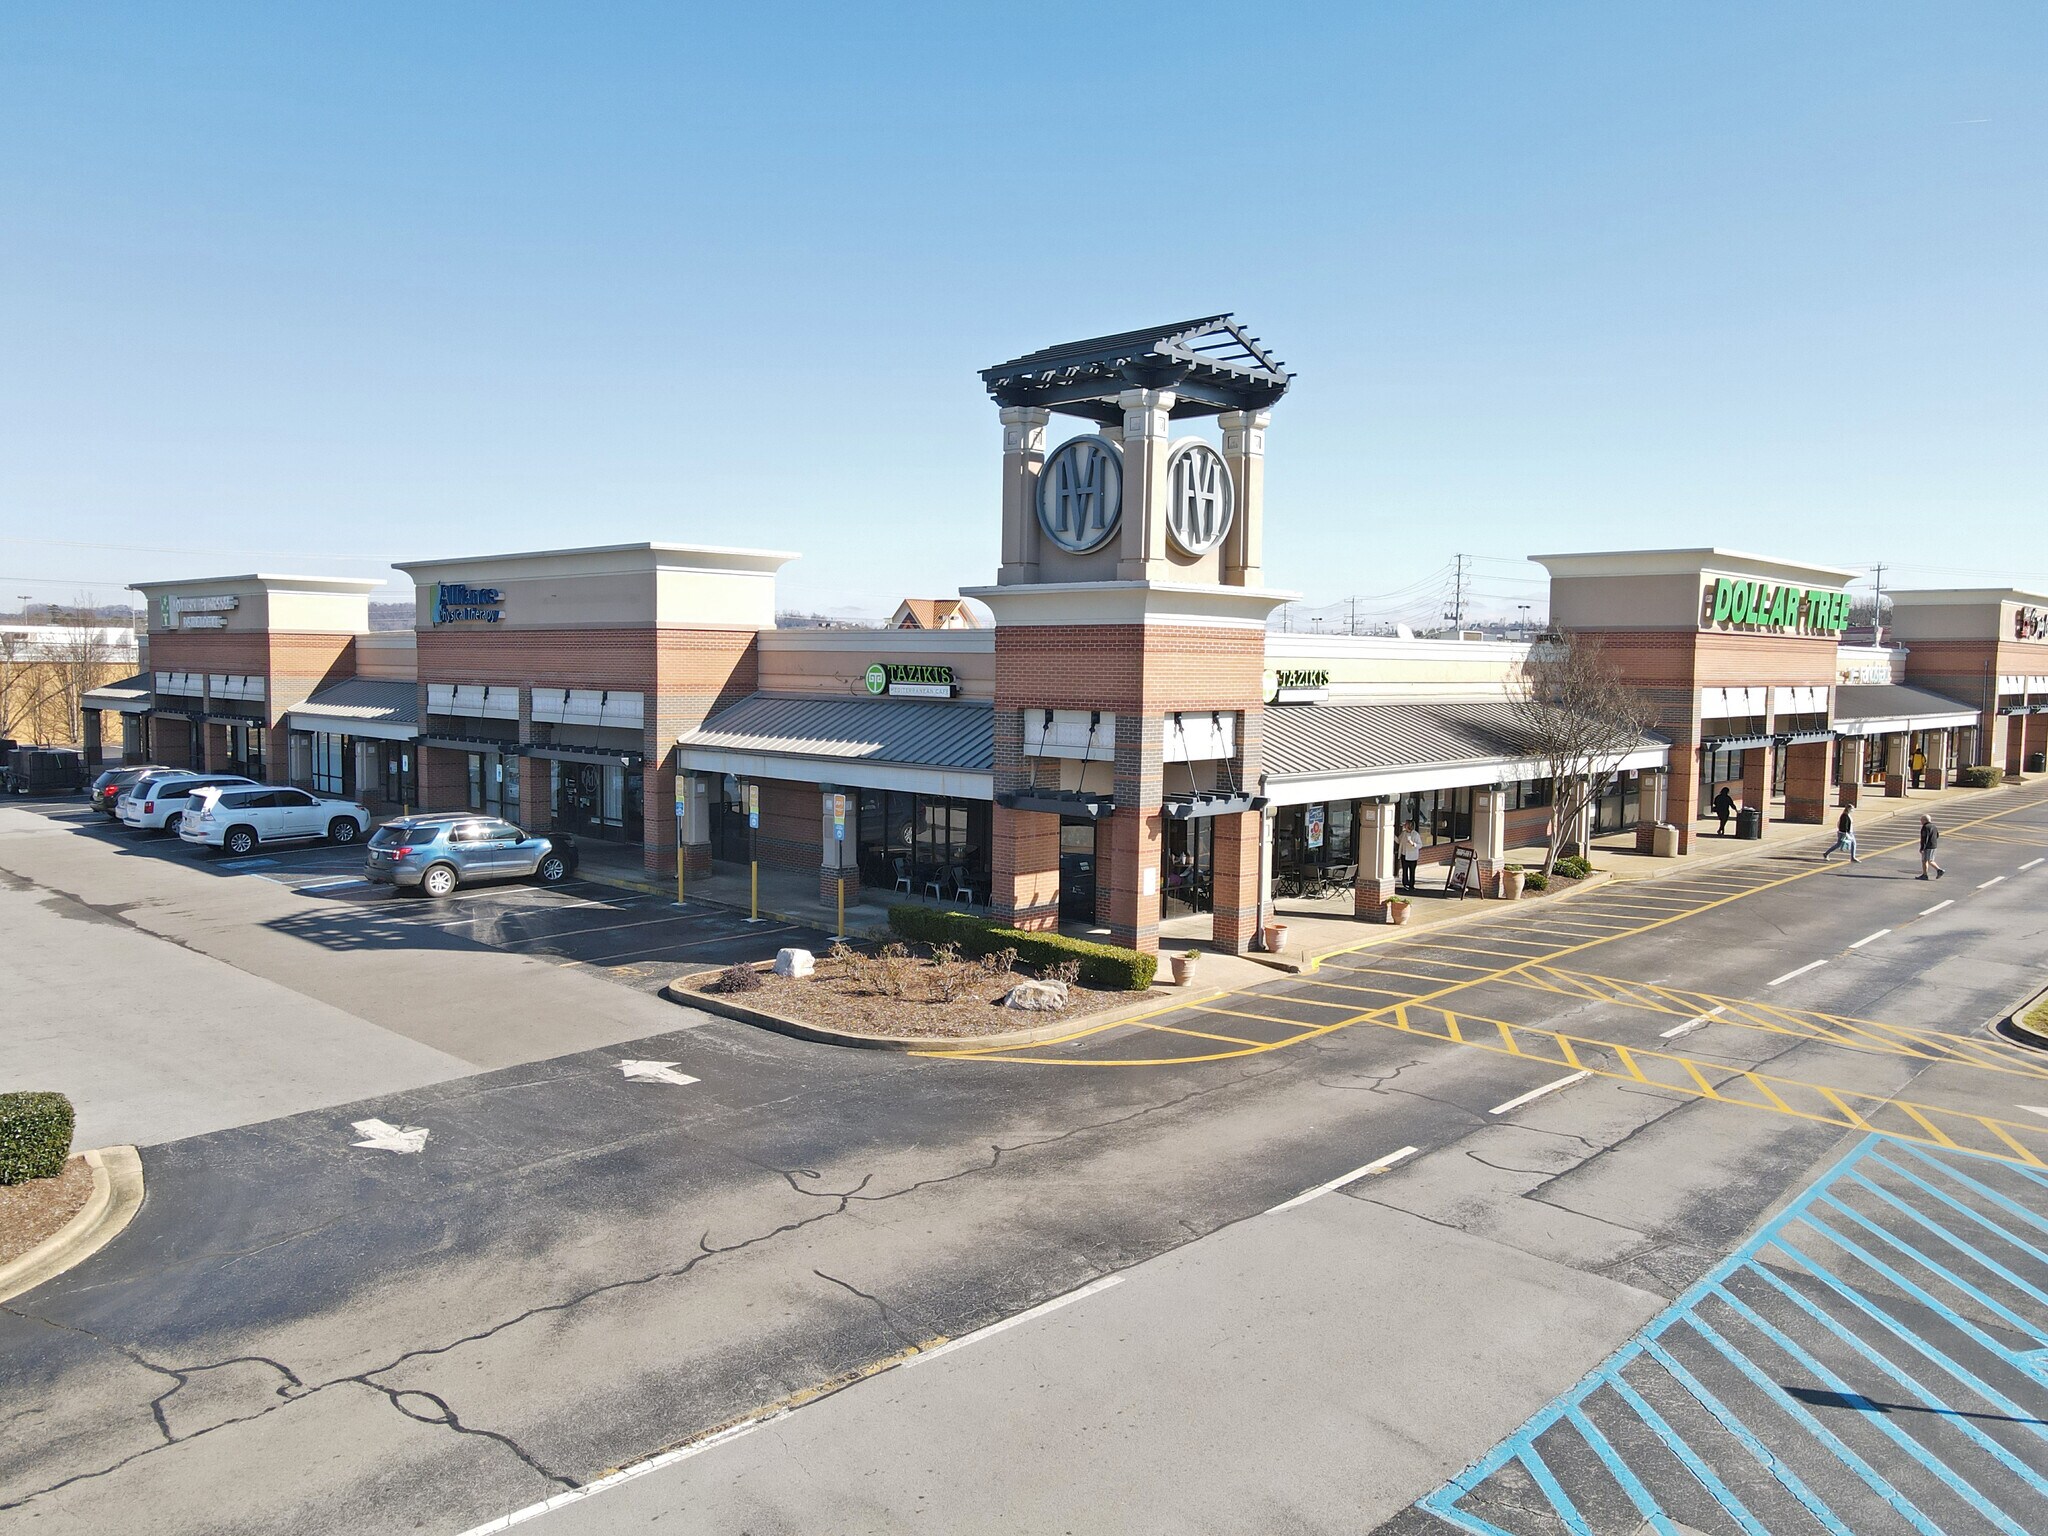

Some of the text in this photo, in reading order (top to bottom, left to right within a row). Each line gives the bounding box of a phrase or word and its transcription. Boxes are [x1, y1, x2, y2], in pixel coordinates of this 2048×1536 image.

[440, 585, 498, 604] Alliance
[1714, 578, 1851, 631] DOLLAR TREE
[467, 608, 495, 623] Therapy
[888, 665, 950, 684] TAZIKI'S
